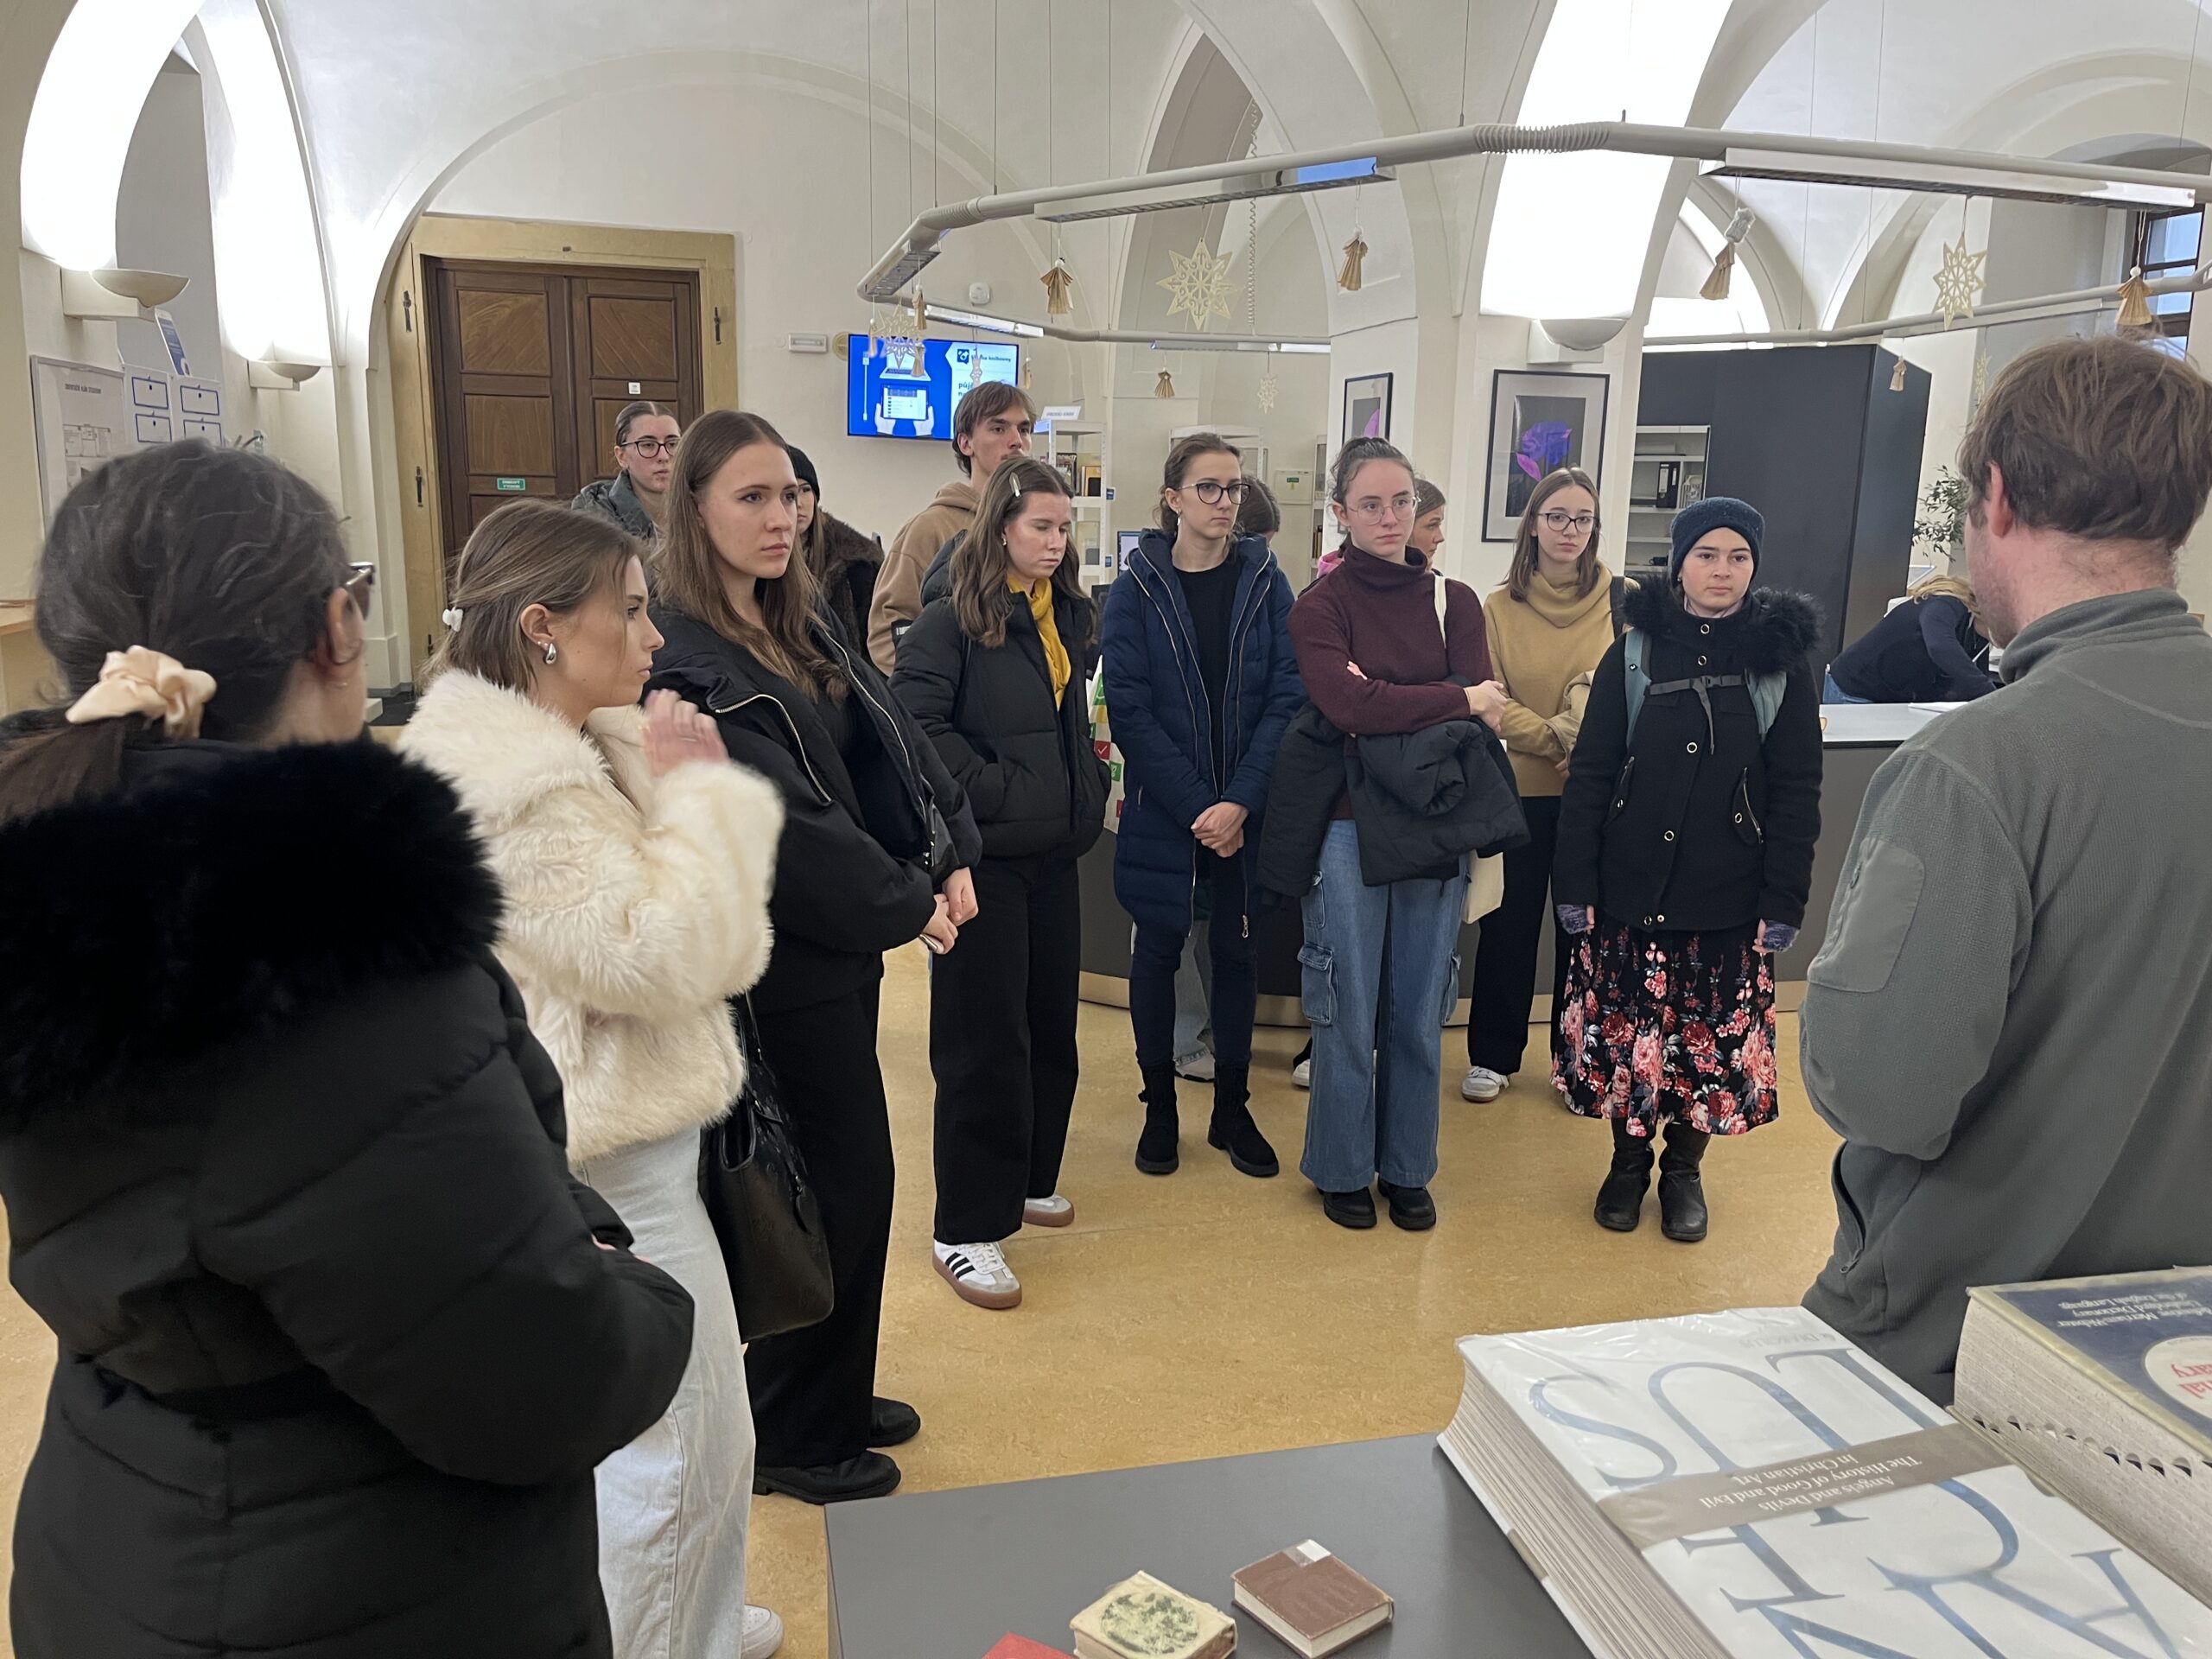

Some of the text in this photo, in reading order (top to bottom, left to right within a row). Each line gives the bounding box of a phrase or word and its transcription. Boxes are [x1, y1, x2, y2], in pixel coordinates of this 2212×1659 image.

[2072, 1306, 2137, 1318] Dictionary
[1700, 1455, 1923, 1510] The History of Good and Evil
[1732, 1453, 1859, 1487] in Christian Art
[1758, 1476, 1895, 1512] Angels and Devils
